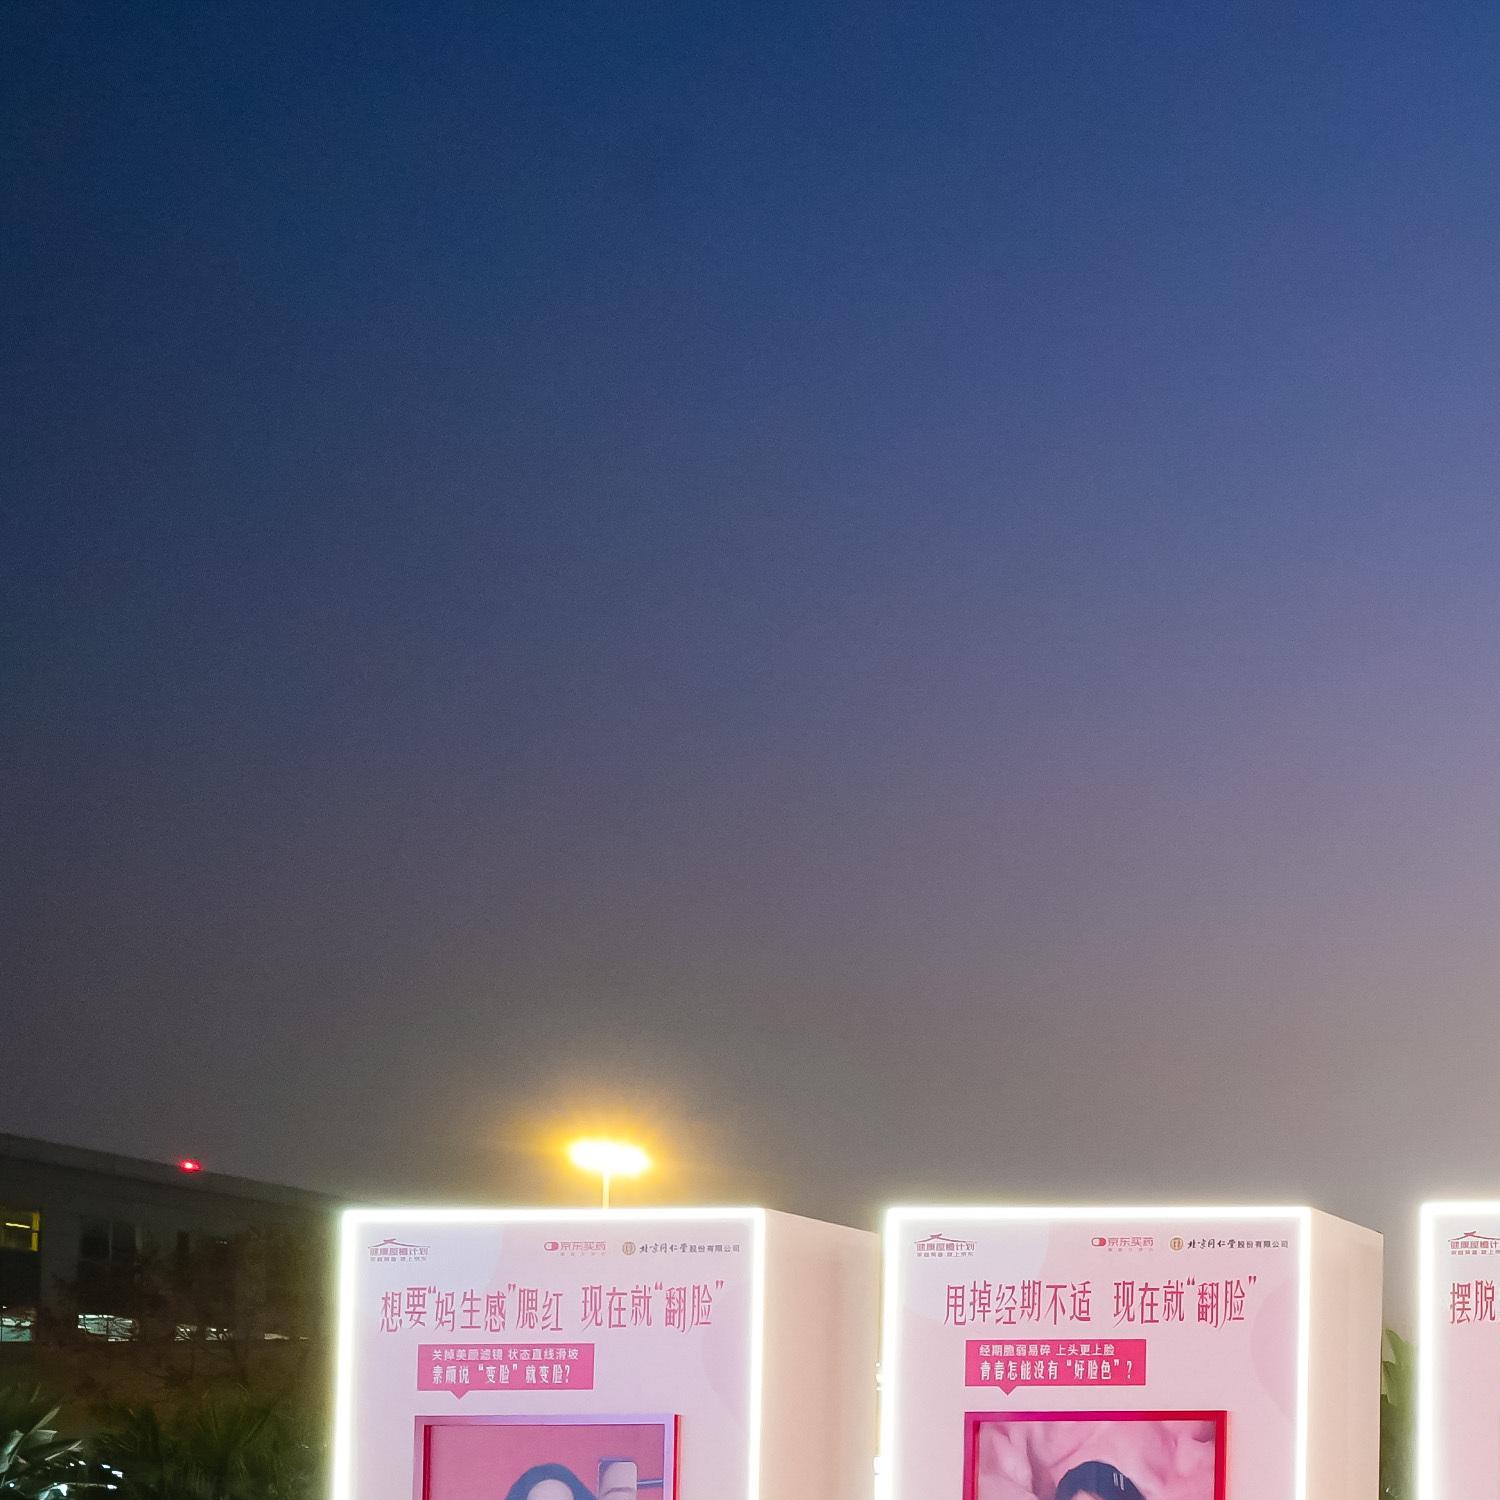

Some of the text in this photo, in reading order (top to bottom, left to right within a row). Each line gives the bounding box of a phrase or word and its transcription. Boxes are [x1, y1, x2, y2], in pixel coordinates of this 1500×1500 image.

[560, 1241, 607, 1251] 京东买药
[1108, 1237, 1154, 1247] 京东买药
[379, 1280, 725, 1334] 想要“妈生感”腮红 现在就“翻脸”
[943, 1275, 1257, 1329] 甩掉经期不适 现在就“翻脸”
[1055, 1343, 1115, 1356] 上头更上脸
